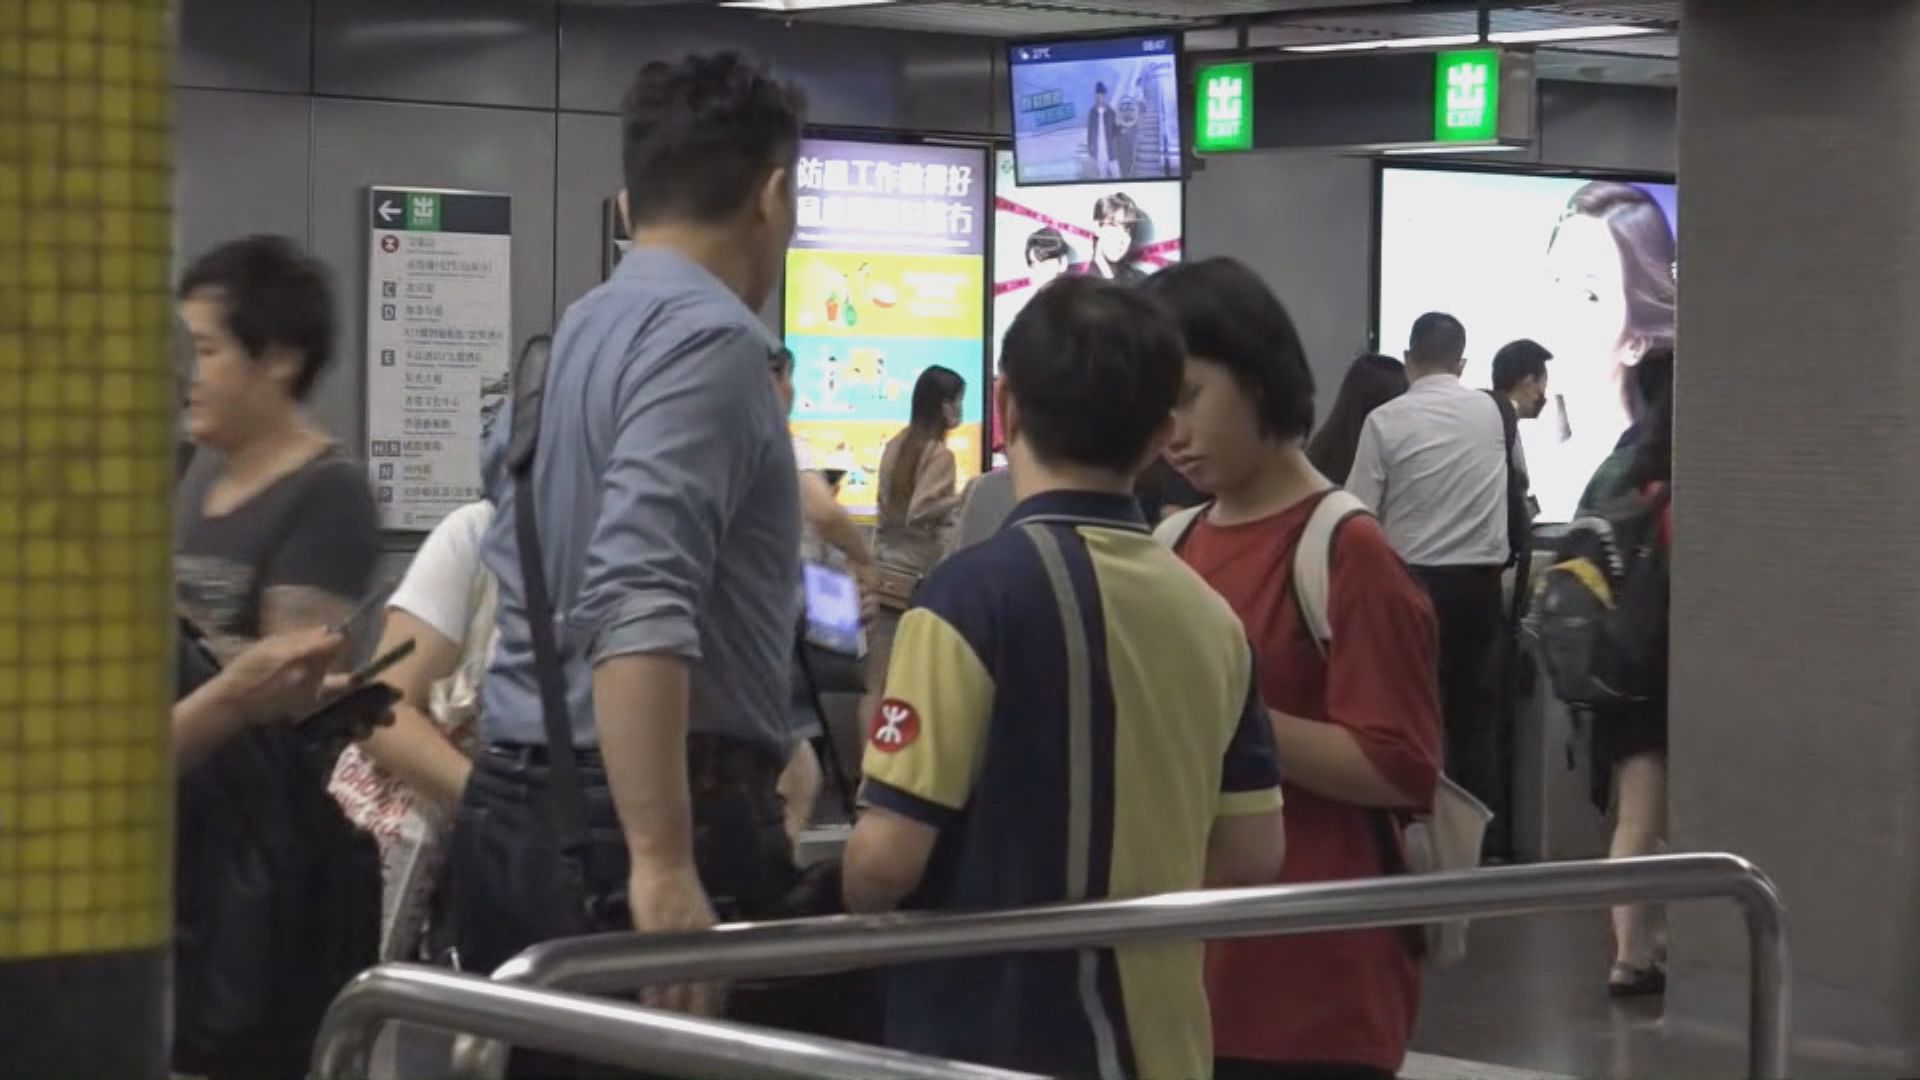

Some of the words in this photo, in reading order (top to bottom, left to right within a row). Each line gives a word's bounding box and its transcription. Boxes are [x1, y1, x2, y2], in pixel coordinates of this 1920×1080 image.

[1207, 76, 1243, 120] 出
[1447, 63, 1488, 109] 出
[1206, 121, 1240, 138] EXIT
[1446, 110, 1484, 128] EXIT
